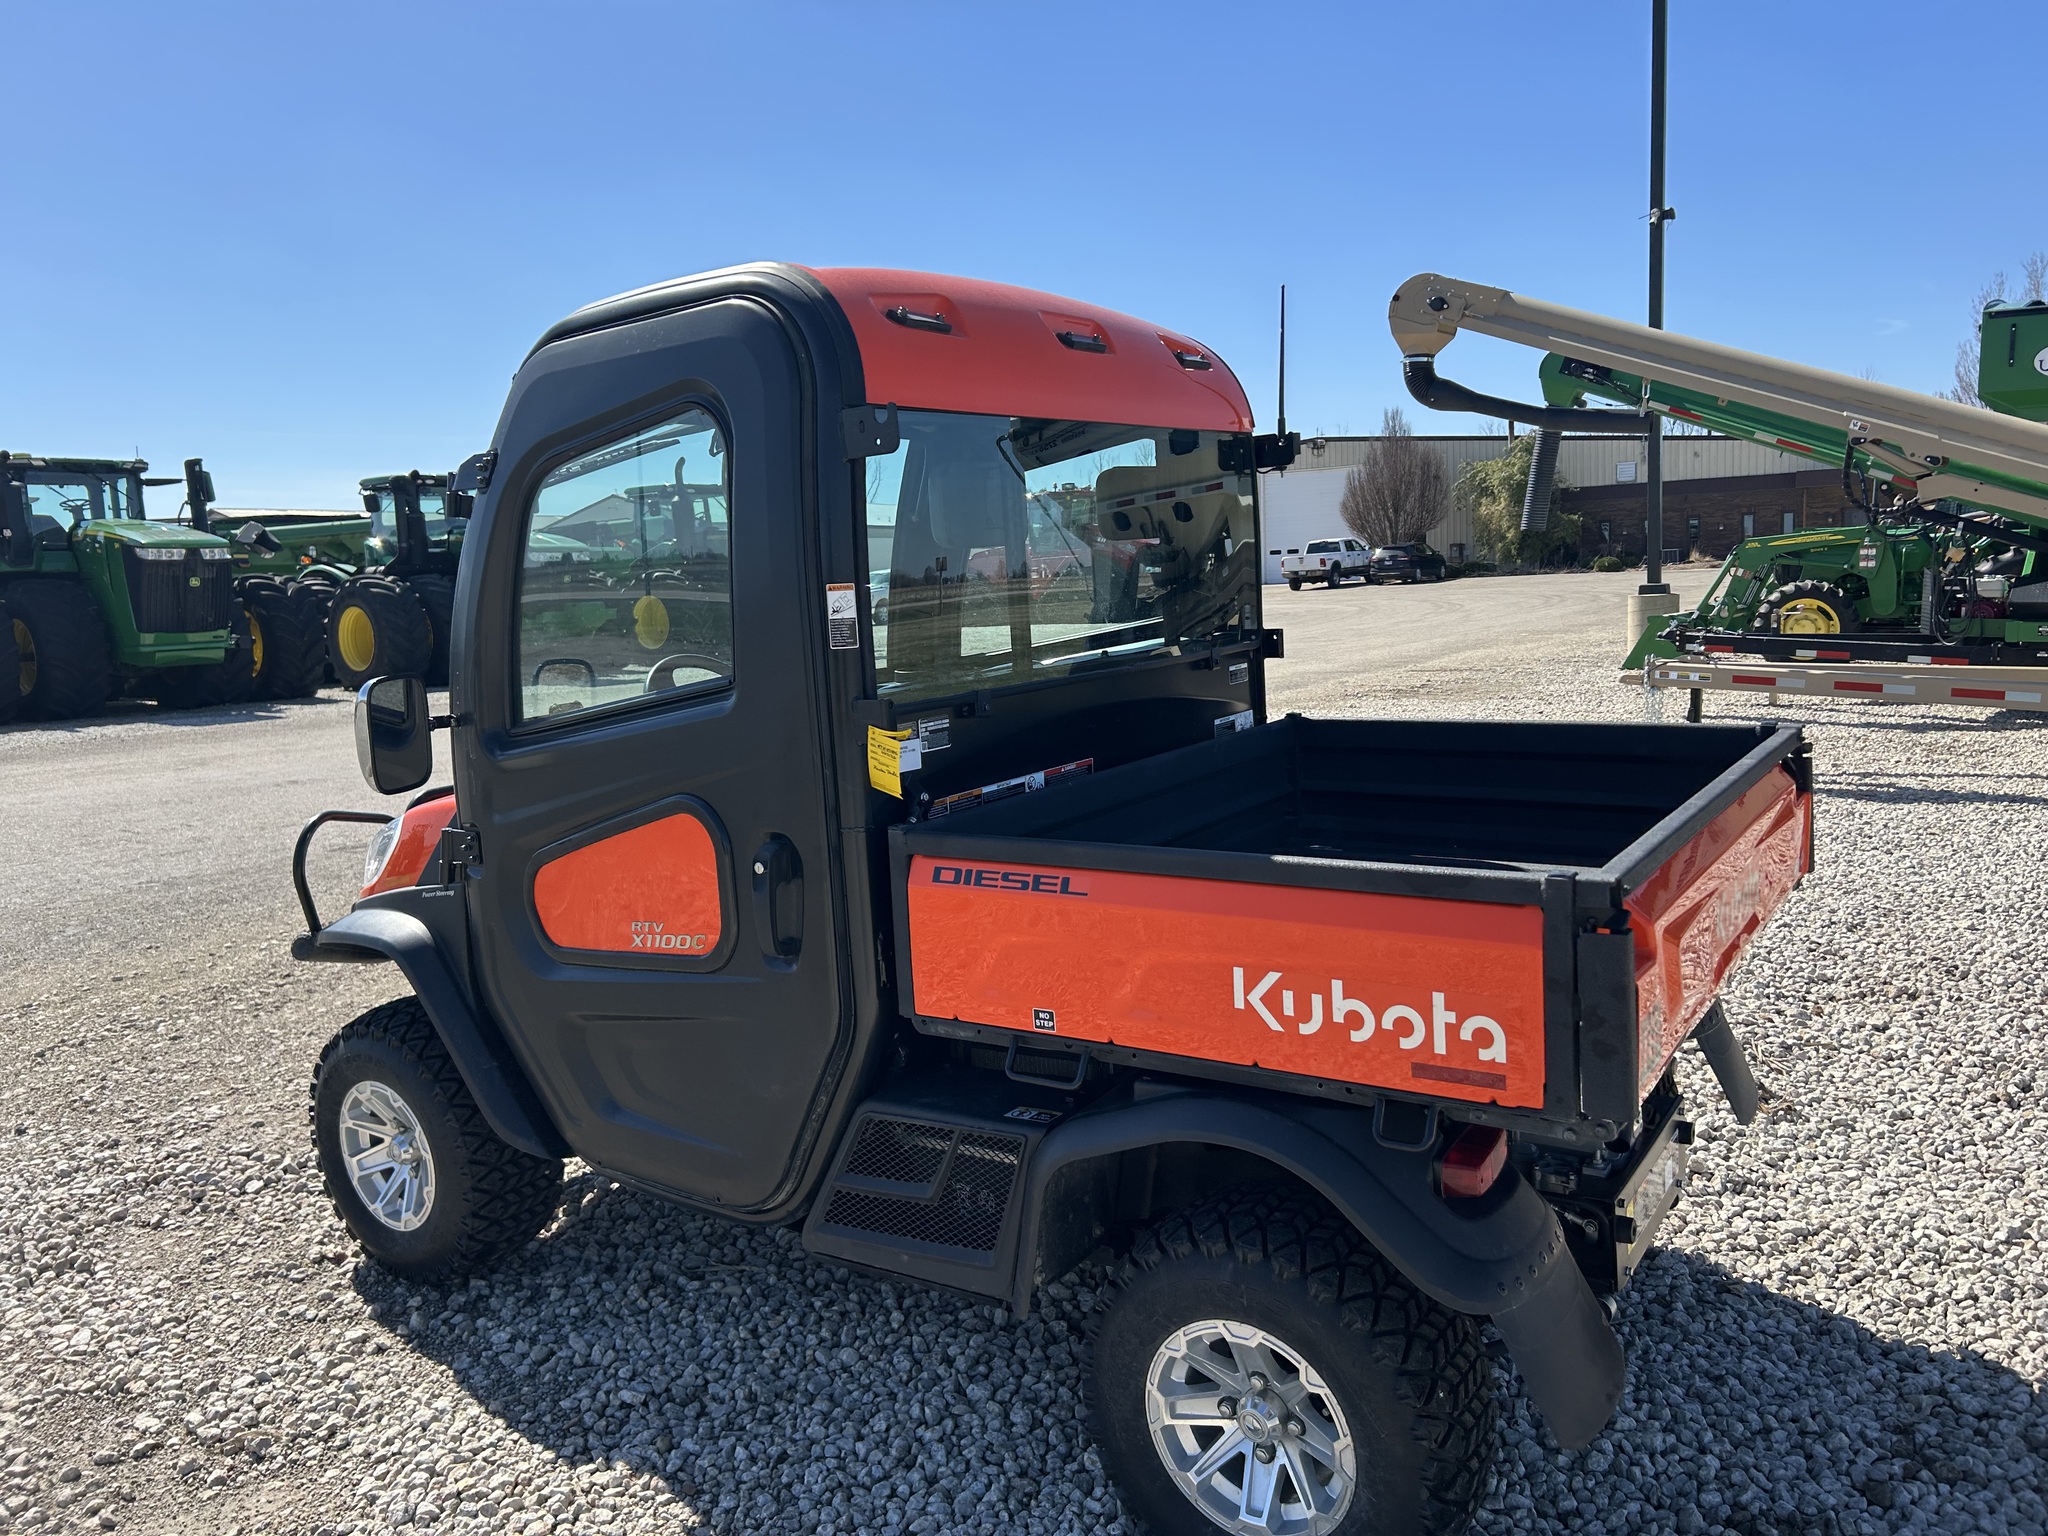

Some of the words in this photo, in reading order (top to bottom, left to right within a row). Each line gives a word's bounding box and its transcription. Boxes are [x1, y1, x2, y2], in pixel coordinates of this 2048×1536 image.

[932, 866, 1088, 896] DIESEL
[631, 921, 664, 933] RTV
[631, 934, 706, 950] X1100C
[1035, 1019, 1053, 1027] STEP
[1233, 966, 1507, 1064] Kubota
